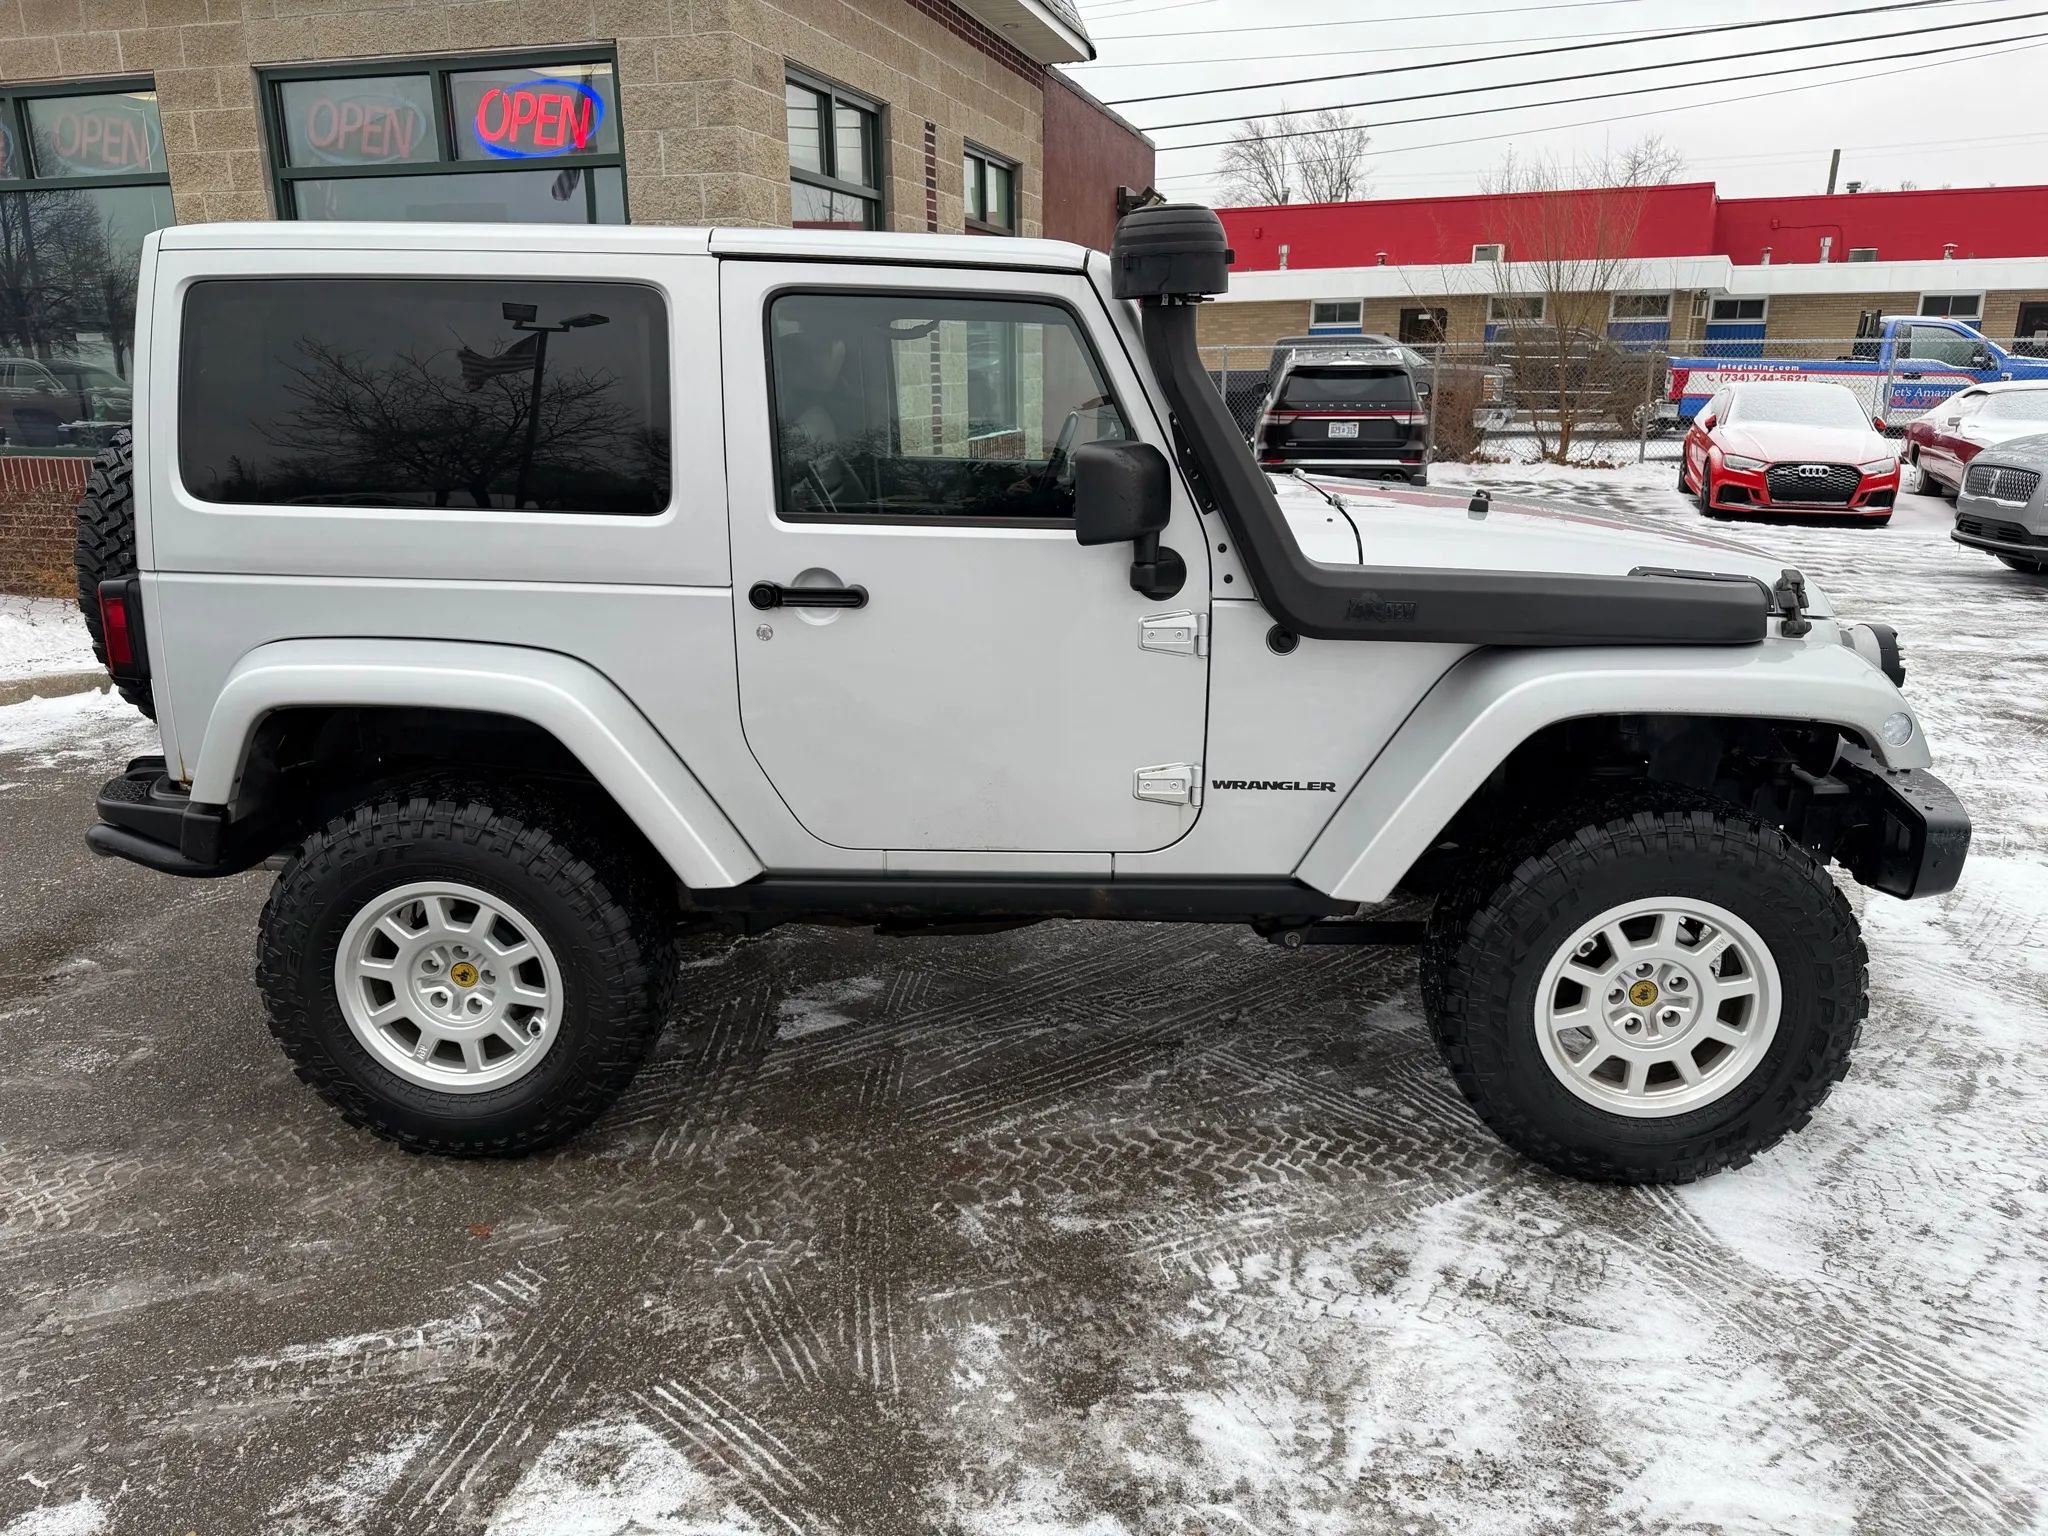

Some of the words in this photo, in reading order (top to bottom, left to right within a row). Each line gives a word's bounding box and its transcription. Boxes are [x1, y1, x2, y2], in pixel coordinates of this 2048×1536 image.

[307, 97, 415, 159] OPEN
[477, 88, 592, 149] OPEN
[54, 111, 148, 168] OPEN
[1720, 373, 1749, 382] (734)
[1890, 386, 1912, 397] Jet's
[1914, 387, 1958, 397] Amazin
[1212, 780, 1336, 792] WRANGLER
